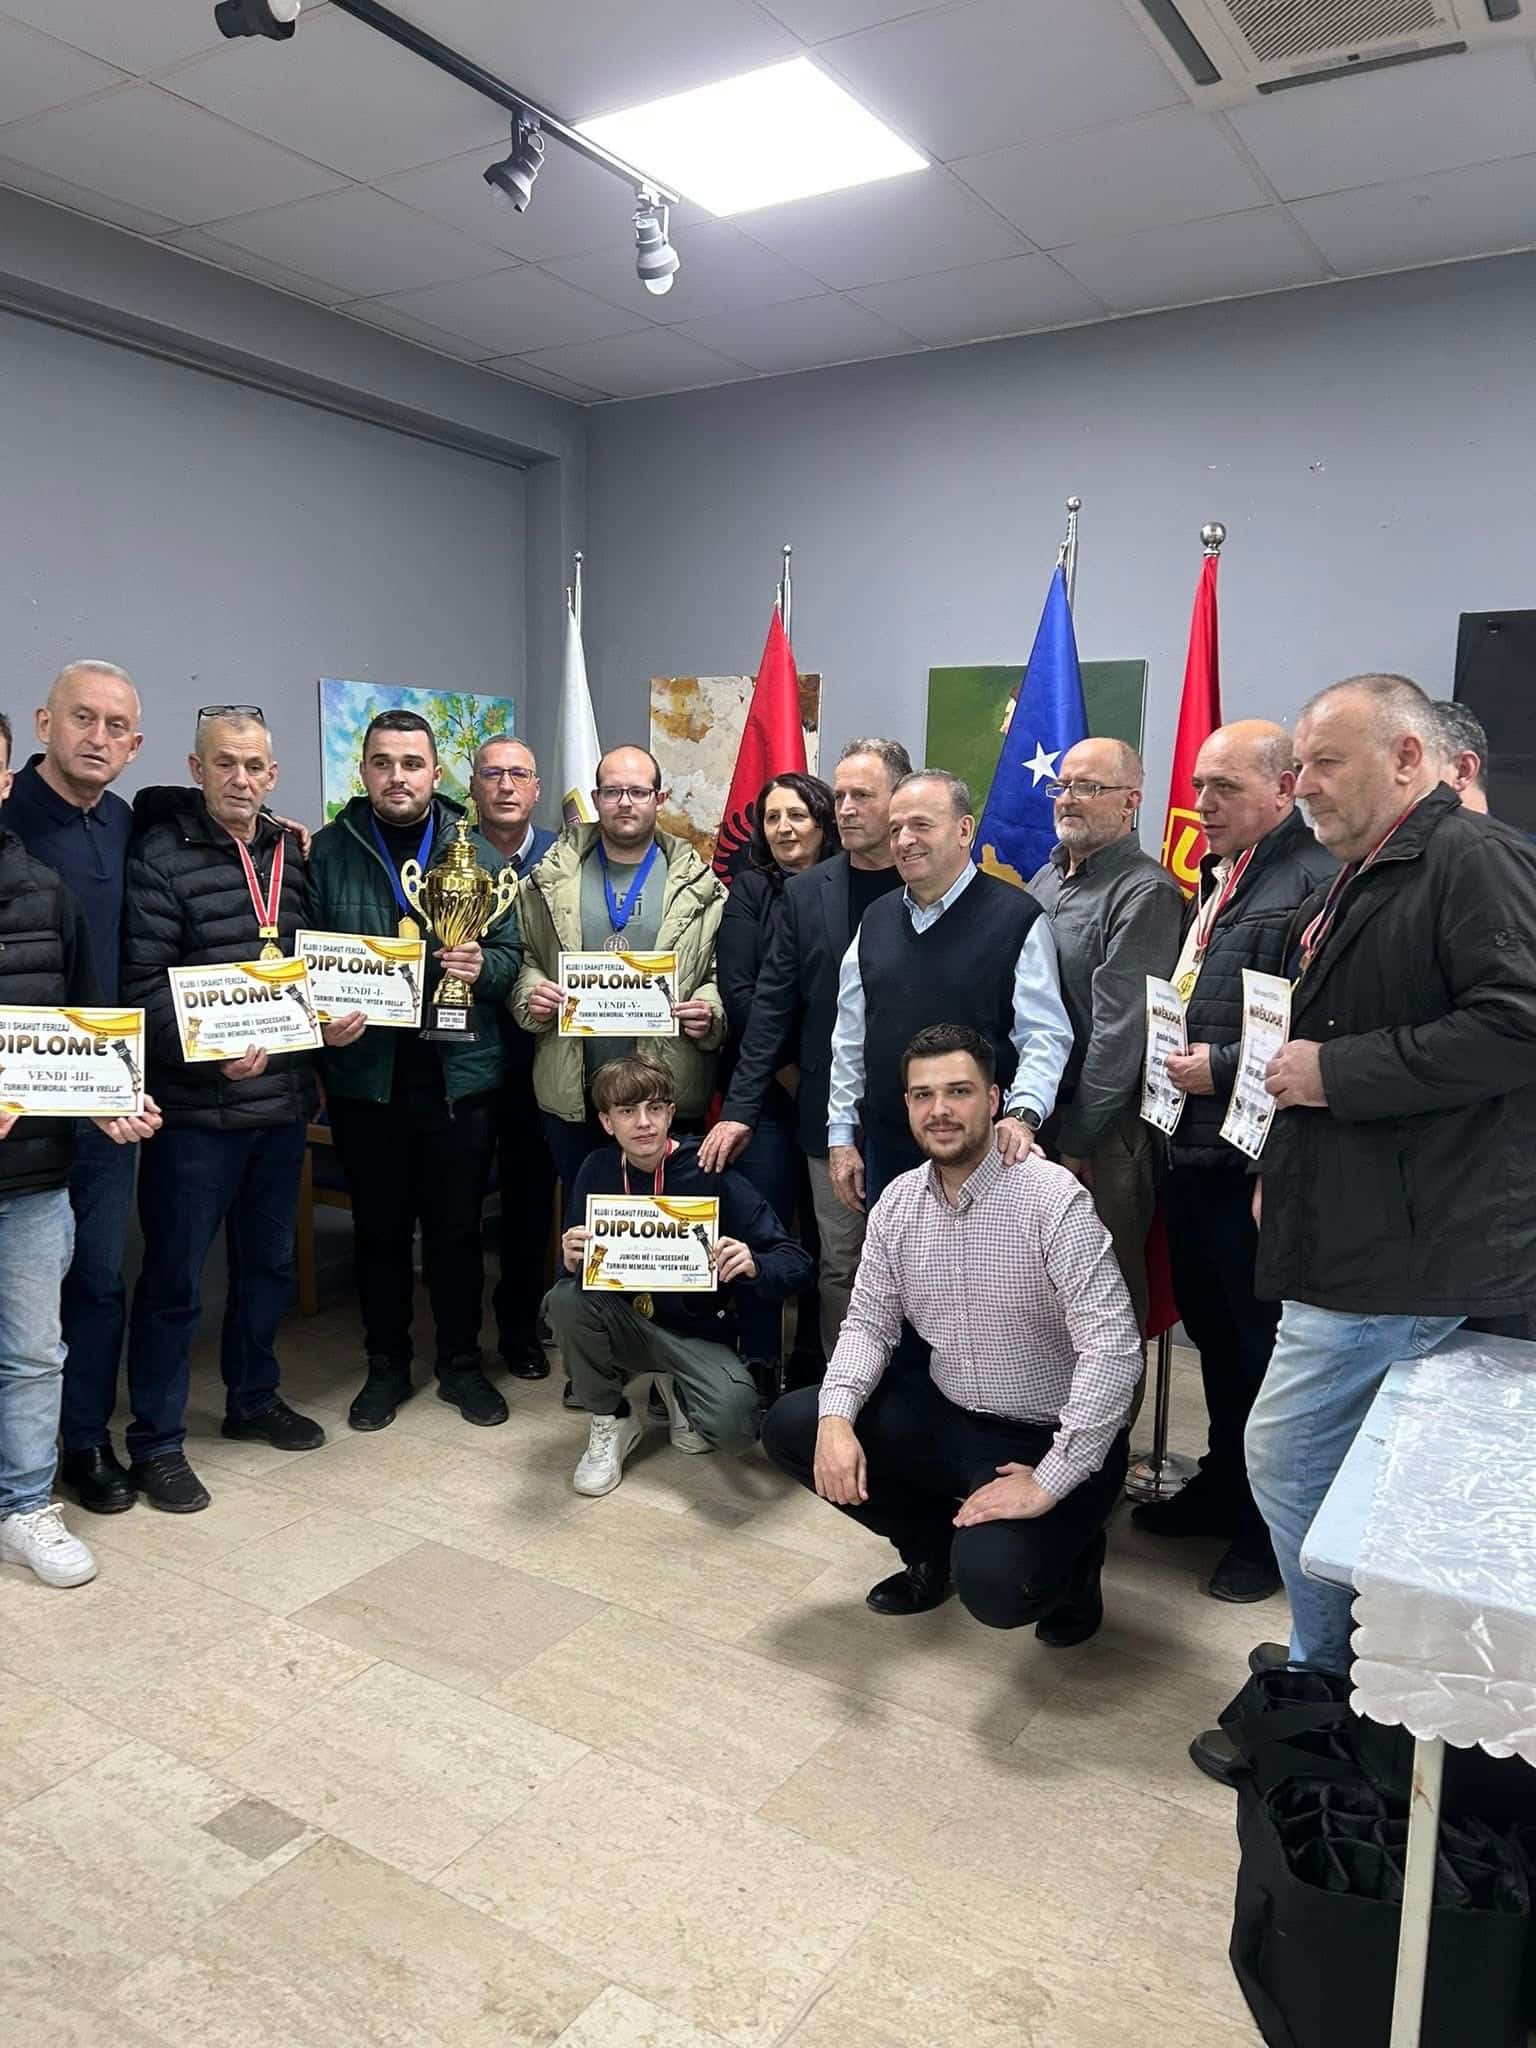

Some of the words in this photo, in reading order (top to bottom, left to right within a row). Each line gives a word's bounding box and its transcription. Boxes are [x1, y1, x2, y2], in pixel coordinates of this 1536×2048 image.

[305, 954, 397, 976] DIPLOMË
[567, 970, 654, 990] DIPLOMË
[184, 980, 283, 1008] DIPLOMË
[341, 985, 373, 996] VENDI
[598, 1001, 626, 1009] VENDI
[28, 1070, 68, 1081] VENDI
[594, 1218, 690, 1239] DIPLOMË
